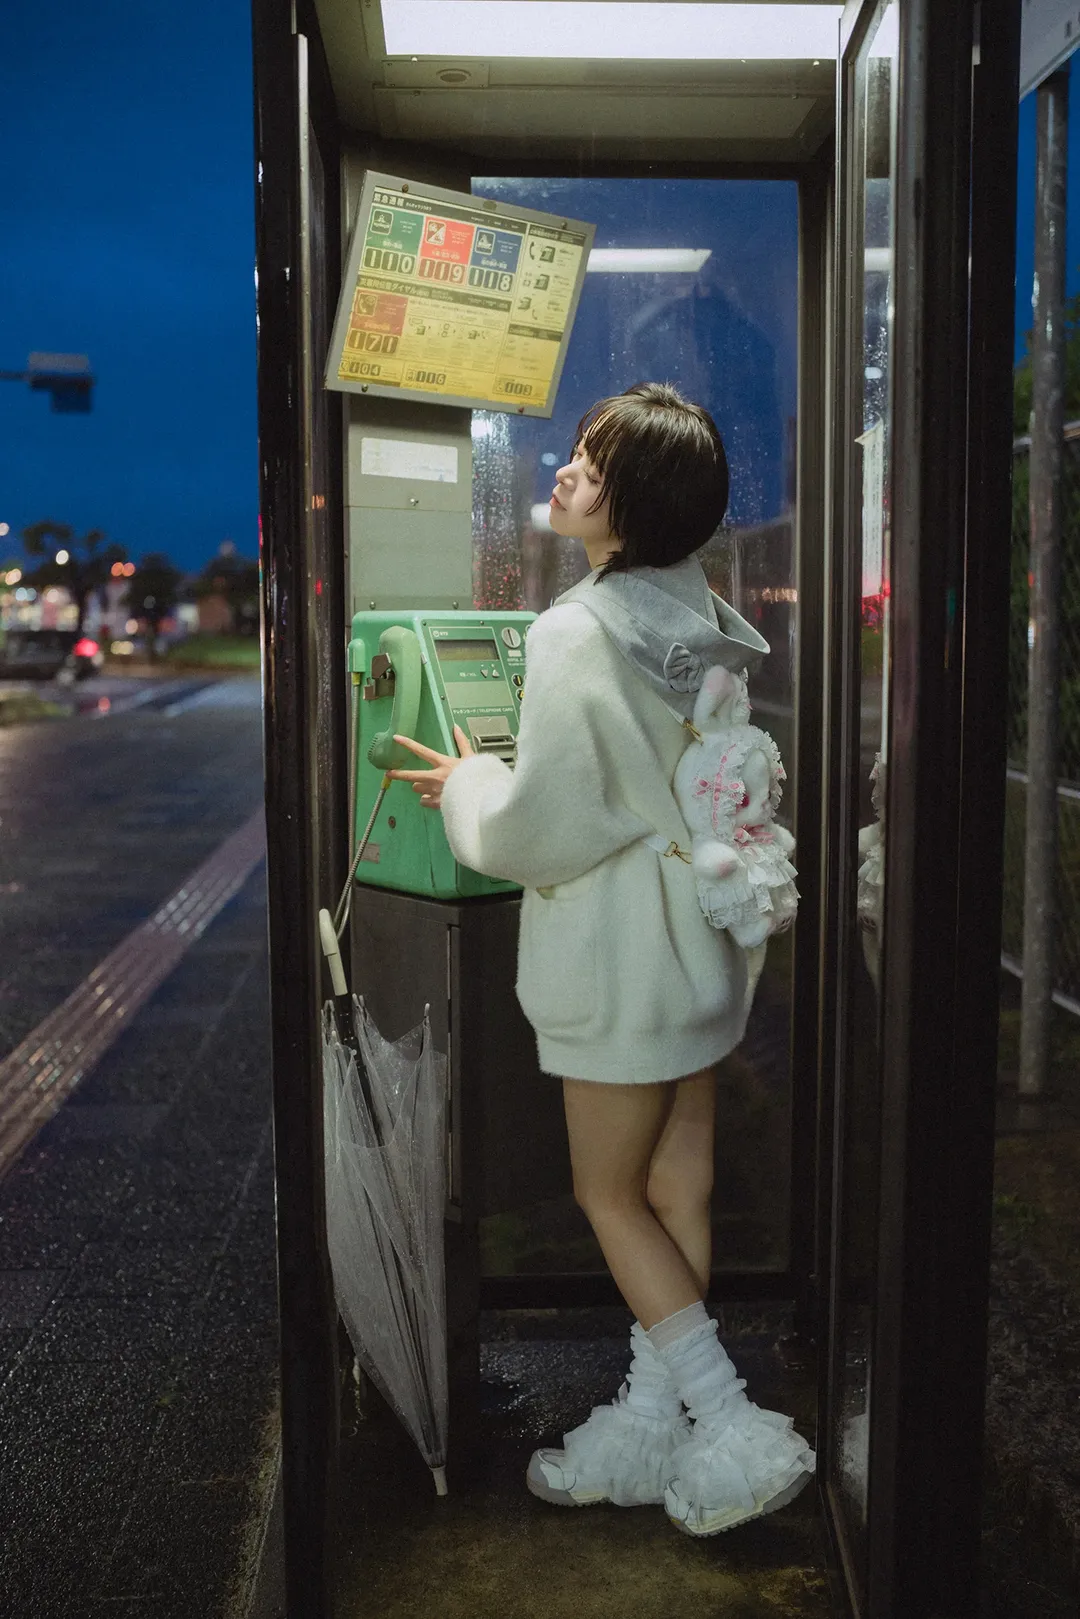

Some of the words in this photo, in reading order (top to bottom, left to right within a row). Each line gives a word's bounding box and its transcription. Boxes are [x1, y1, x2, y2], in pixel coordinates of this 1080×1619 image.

[369, 250, 414, 274] 110
[423, 260, 462, 283] 119
[473, 269, 512, 291] 118
[353, 332, 393, 352] 171
[352, 362, 379, 376] 104
[418, 371, 444, 384] 116
